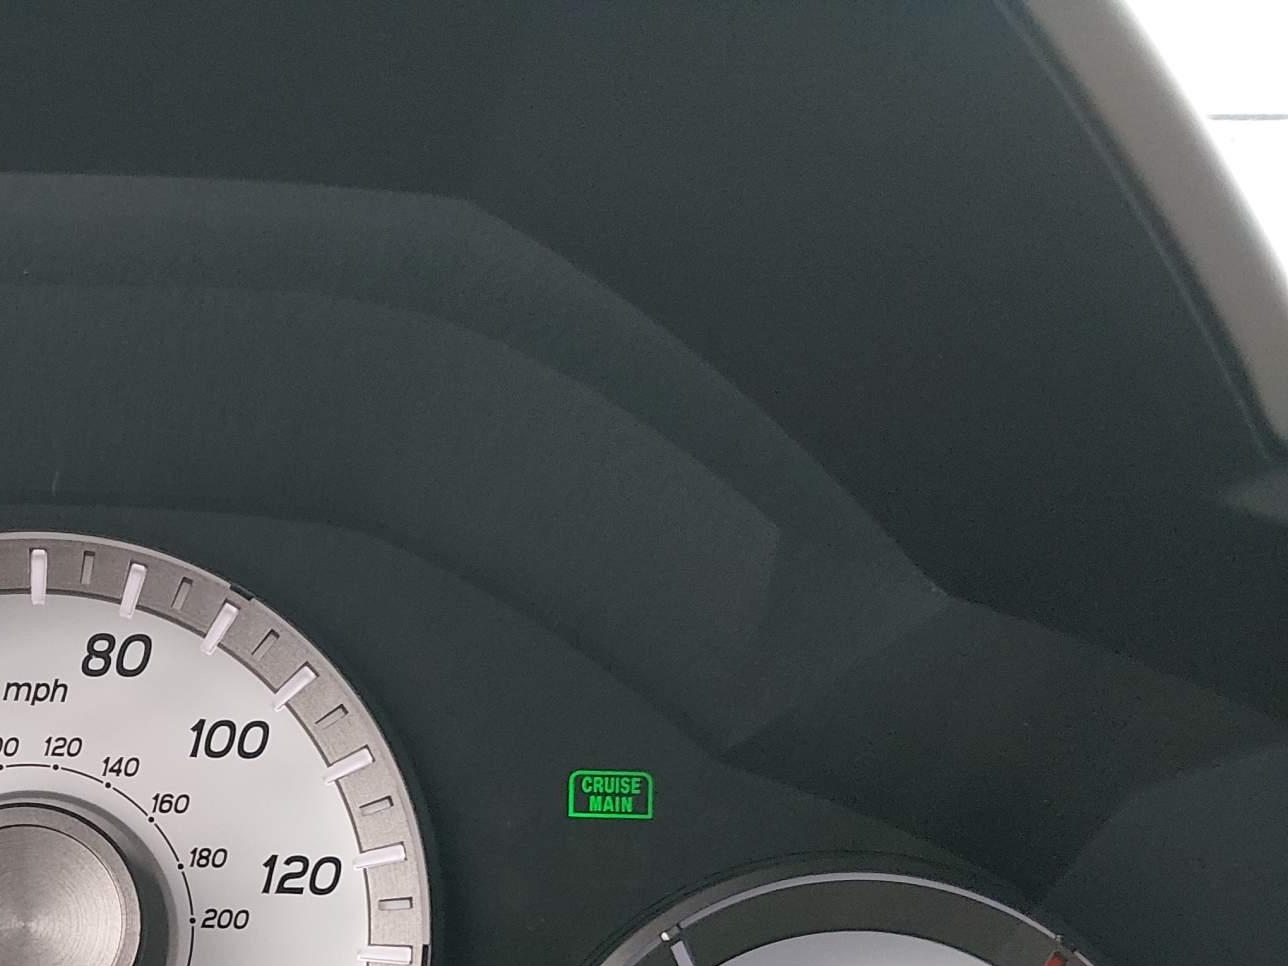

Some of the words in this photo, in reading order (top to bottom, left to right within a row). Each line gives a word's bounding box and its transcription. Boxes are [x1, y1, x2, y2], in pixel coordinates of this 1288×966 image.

[81, 633, 151, 677] 80
[2, 678, 68, 707] mph
[43, 736, 83, 758] 120
[189, 719, 269, 760] 100
[101, 757, 140, 778] 140
[581, 776, 641, 794] CRUISE
[150, 793, 190, 815] 160
[589, 795, 633, 812] MAIN
[188, 847, 228, 869] 180
[261, 855, 342, 896] 120
[201, 909, 249, 931] 200
